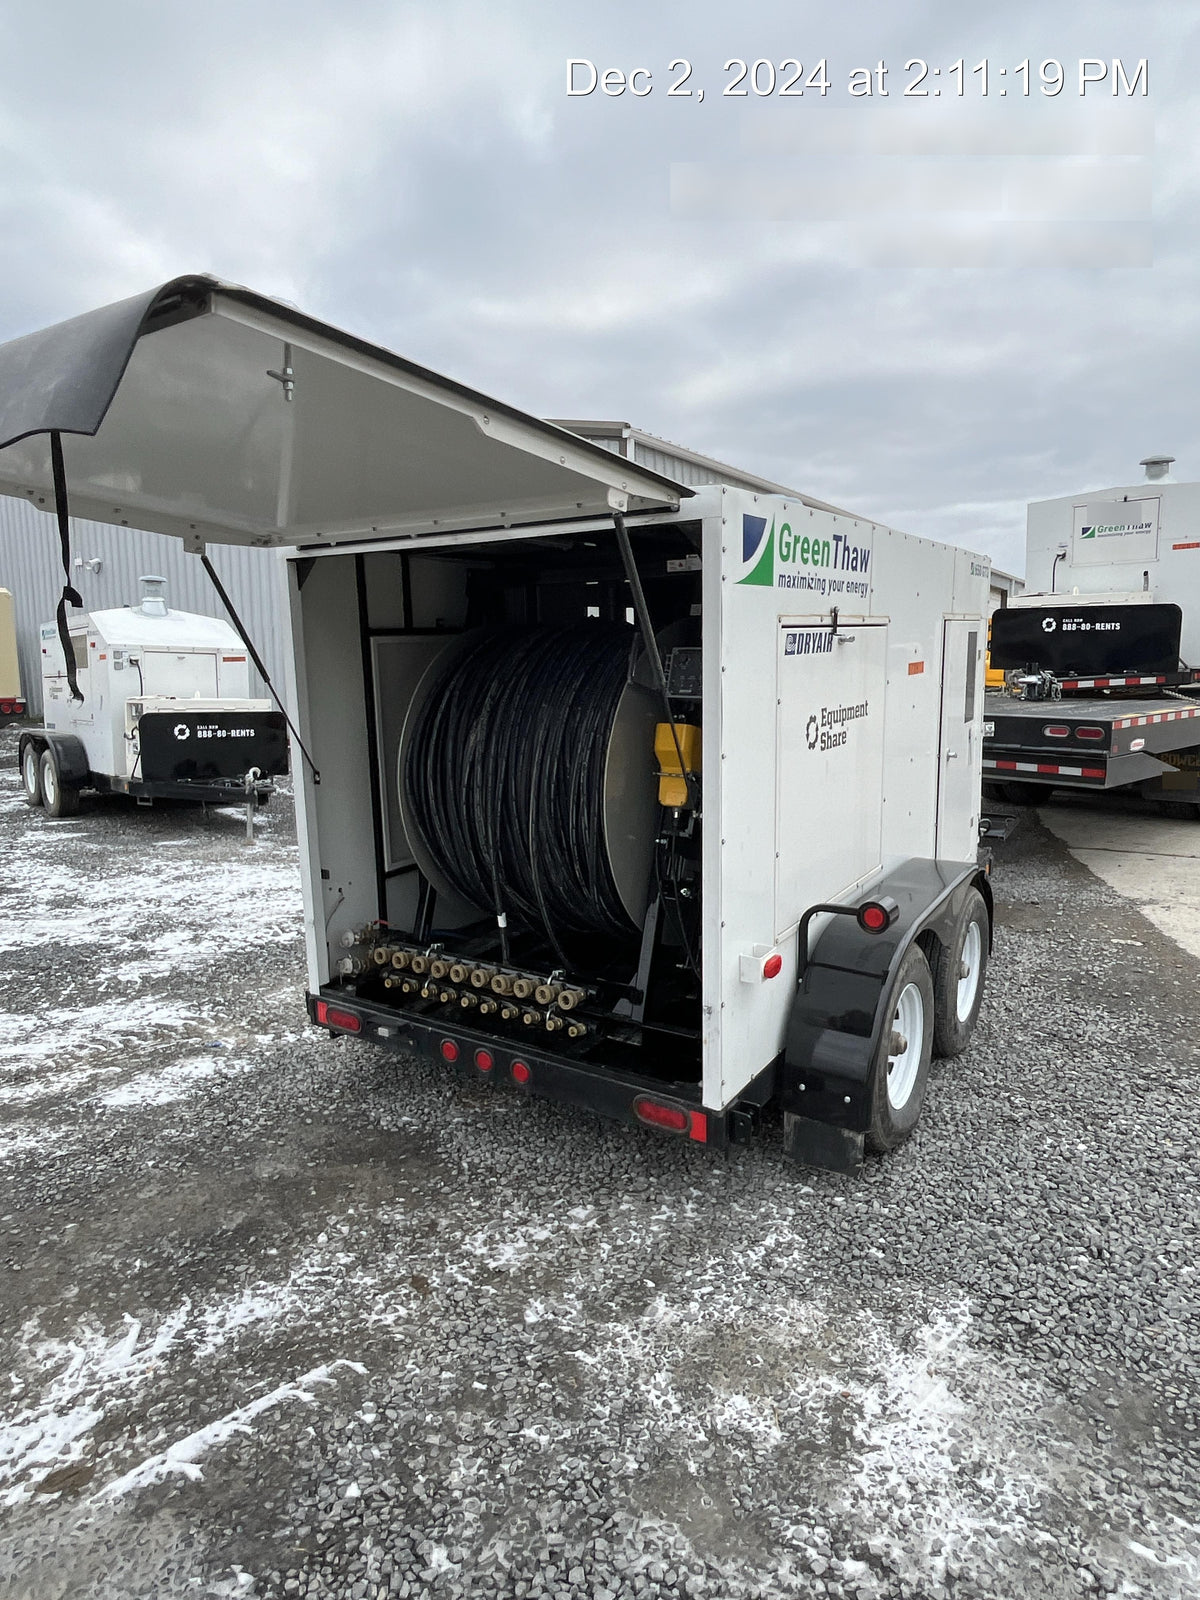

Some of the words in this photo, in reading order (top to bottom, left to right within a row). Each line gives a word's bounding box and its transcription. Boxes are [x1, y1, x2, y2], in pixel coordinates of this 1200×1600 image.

[778, 570, 826, 595] maximizing
[827, 578, 845, 596] your
[846, 580, 869, 598] energy
[1062, 622, 1121, 631] 888-80-RENTS
[796, 632, 834, 655] DRYAIR
[821, 699, 869, 730] Equipment
[197, 729, 255, 738] 888-80-RENTS
[820, 731, 847, 752] Share
